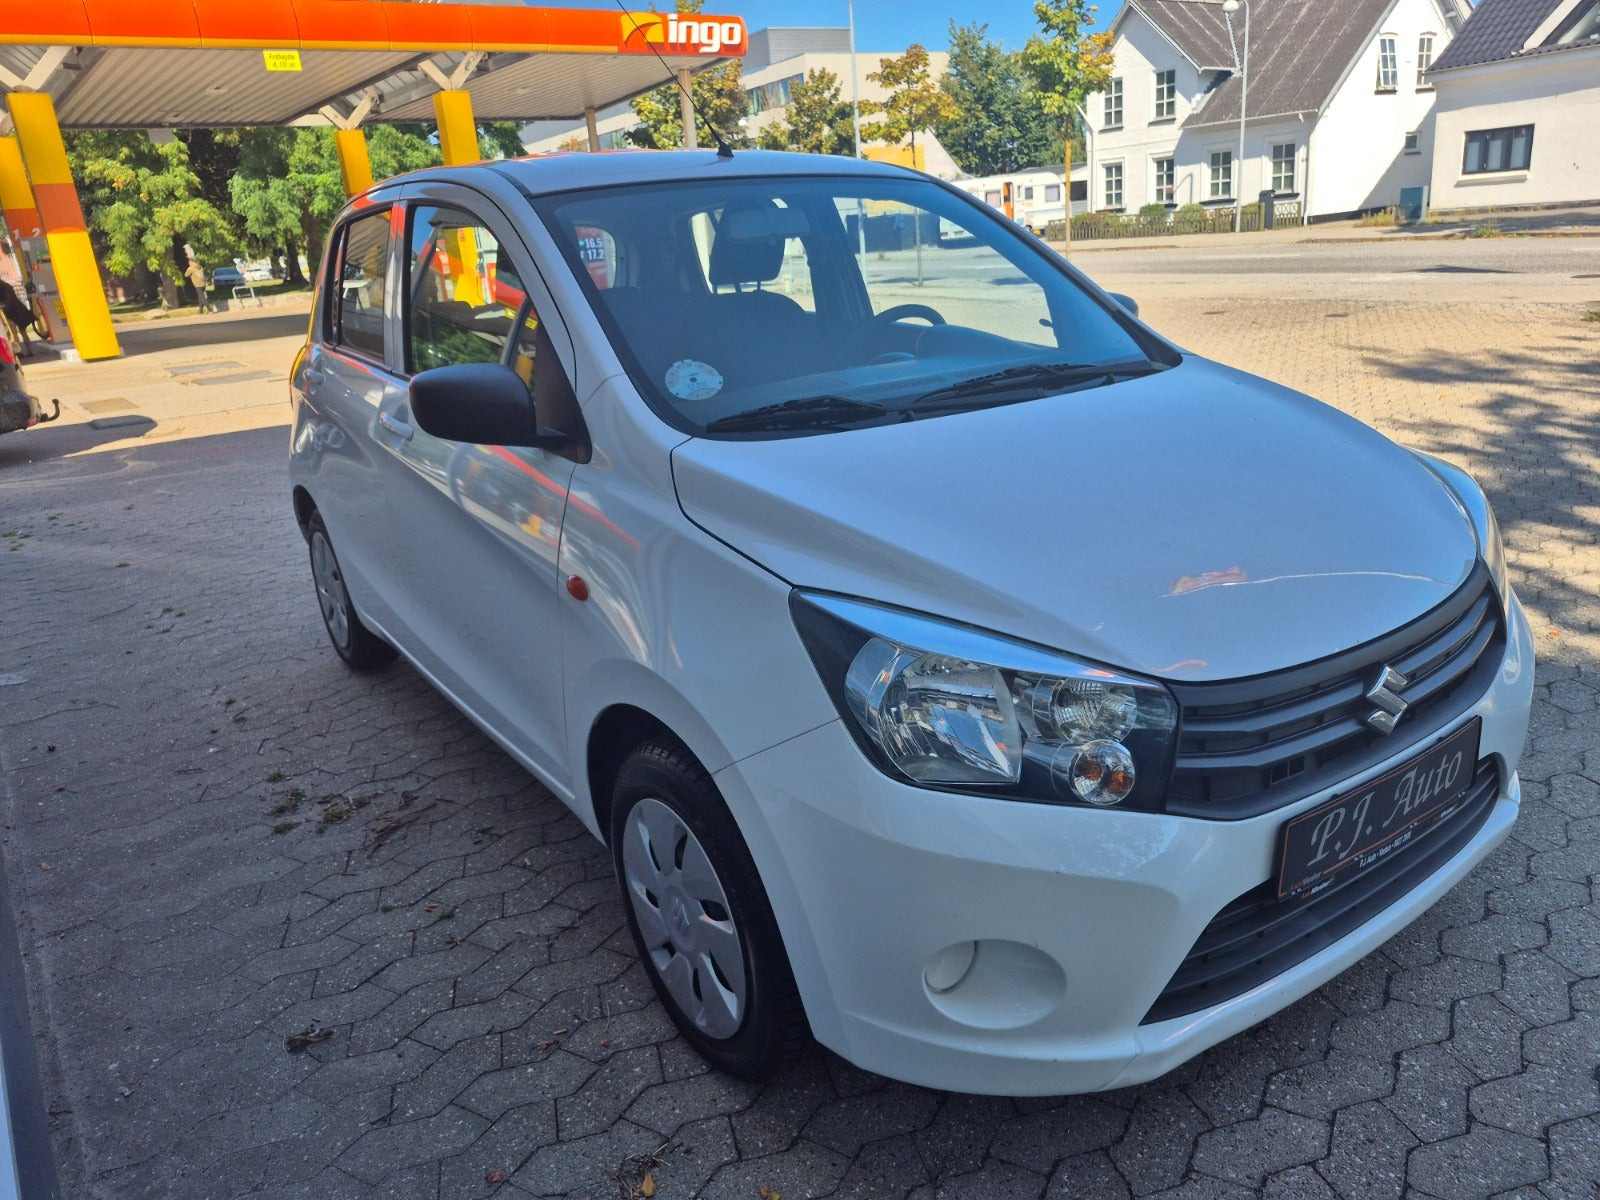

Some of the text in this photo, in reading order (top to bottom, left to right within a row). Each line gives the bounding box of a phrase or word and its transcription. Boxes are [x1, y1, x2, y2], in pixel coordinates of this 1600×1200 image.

[667, 13, 742, 53] ingo
[13, 229, 19, 240] 1
[1307, 751, 1462, 867] P.J. Auto
